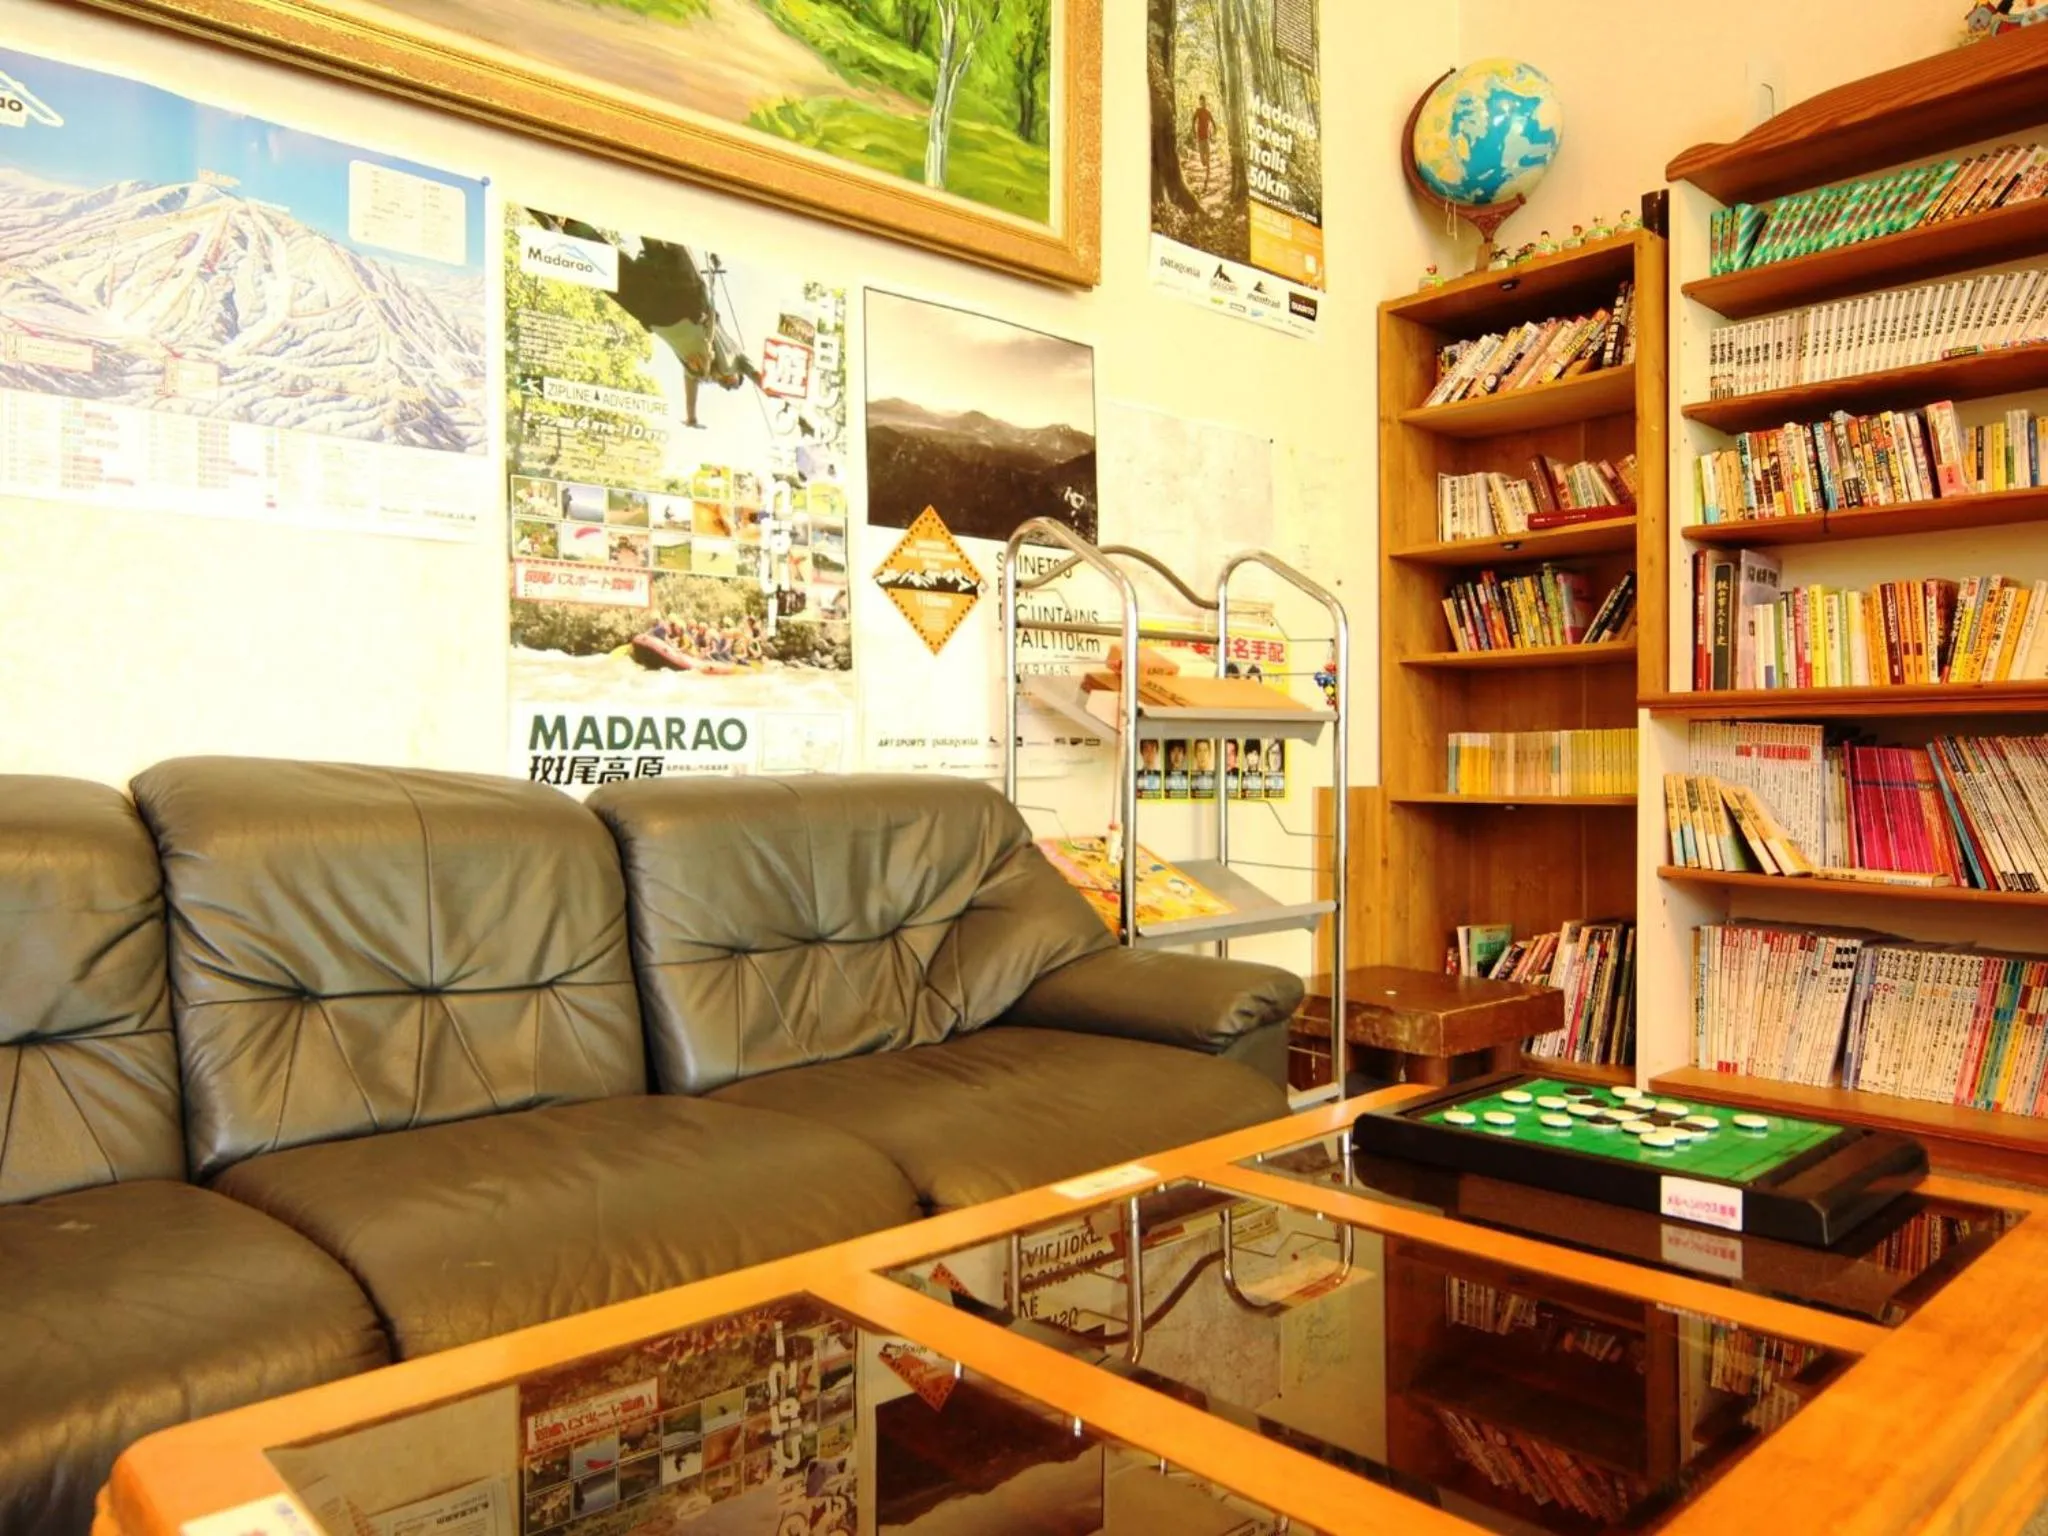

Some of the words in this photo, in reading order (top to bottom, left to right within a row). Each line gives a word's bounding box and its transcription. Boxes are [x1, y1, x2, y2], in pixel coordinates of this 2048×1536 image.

[1249, 143, 1287, 174] Trails
[1249, 169, 1290, 202] 50km
[527, 247, 593, 273] Madarao
[547, 382, 591, 402] ZIPLINE
[602, 392, 670, 415] ADVENTURE
[528, 713, 748, 752] MADARAO
[529, 755, 664, 786] 斑尾高原
